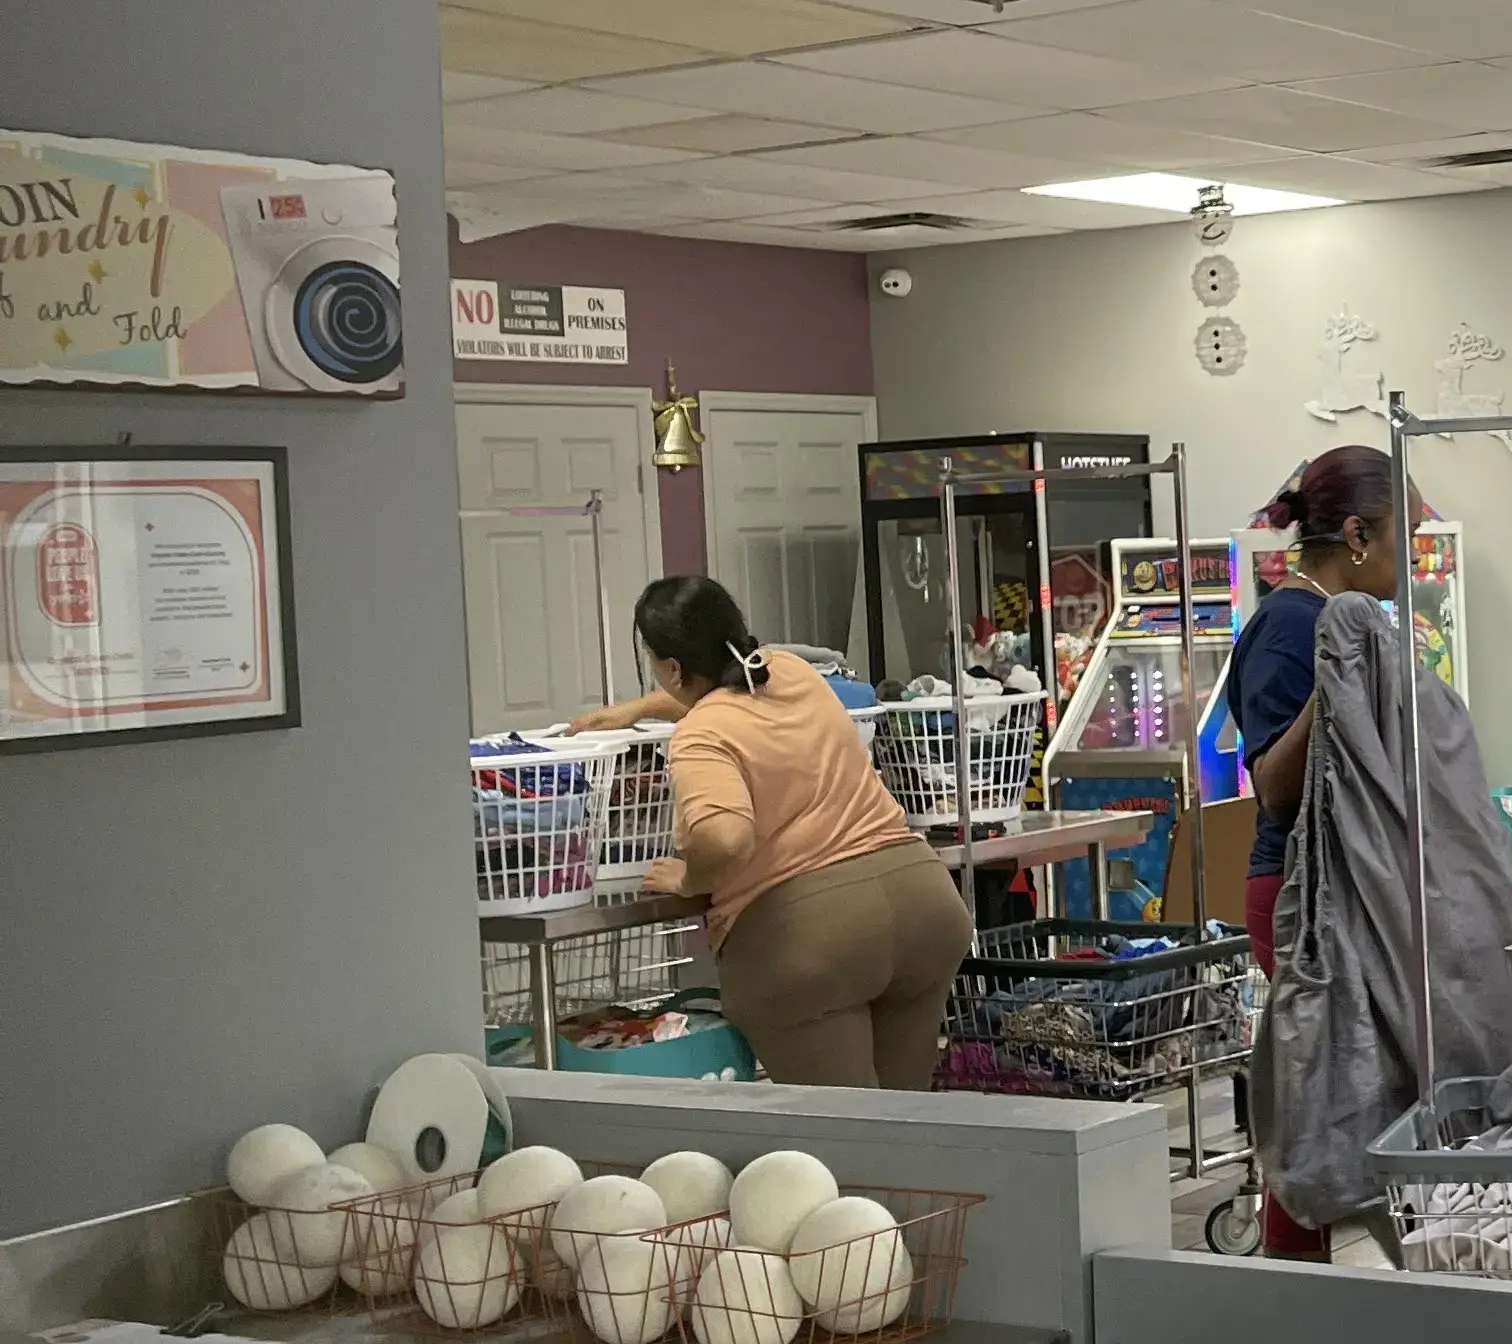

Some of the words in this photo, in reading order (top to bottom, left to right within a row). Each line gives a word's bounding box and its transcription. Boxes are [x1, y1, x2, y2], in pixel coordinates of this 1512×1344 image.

[38, 283, 100, 321] and
[456, 289, 494, 325] NO
[587, 297, 604, 312] ON
[113, 306, 188, 345] Fold
[568, 315, 626, 331] PREMISES
[457, 339, 505, 354] VIOLATORS
[507, 342, 526, 356] WILL
[530, 343, 542, 356] BE
[544, 343, 579, 358] SUBJECT
[581, 345, 593, 358] TO
[595, 346, 626, 360] ARREST
